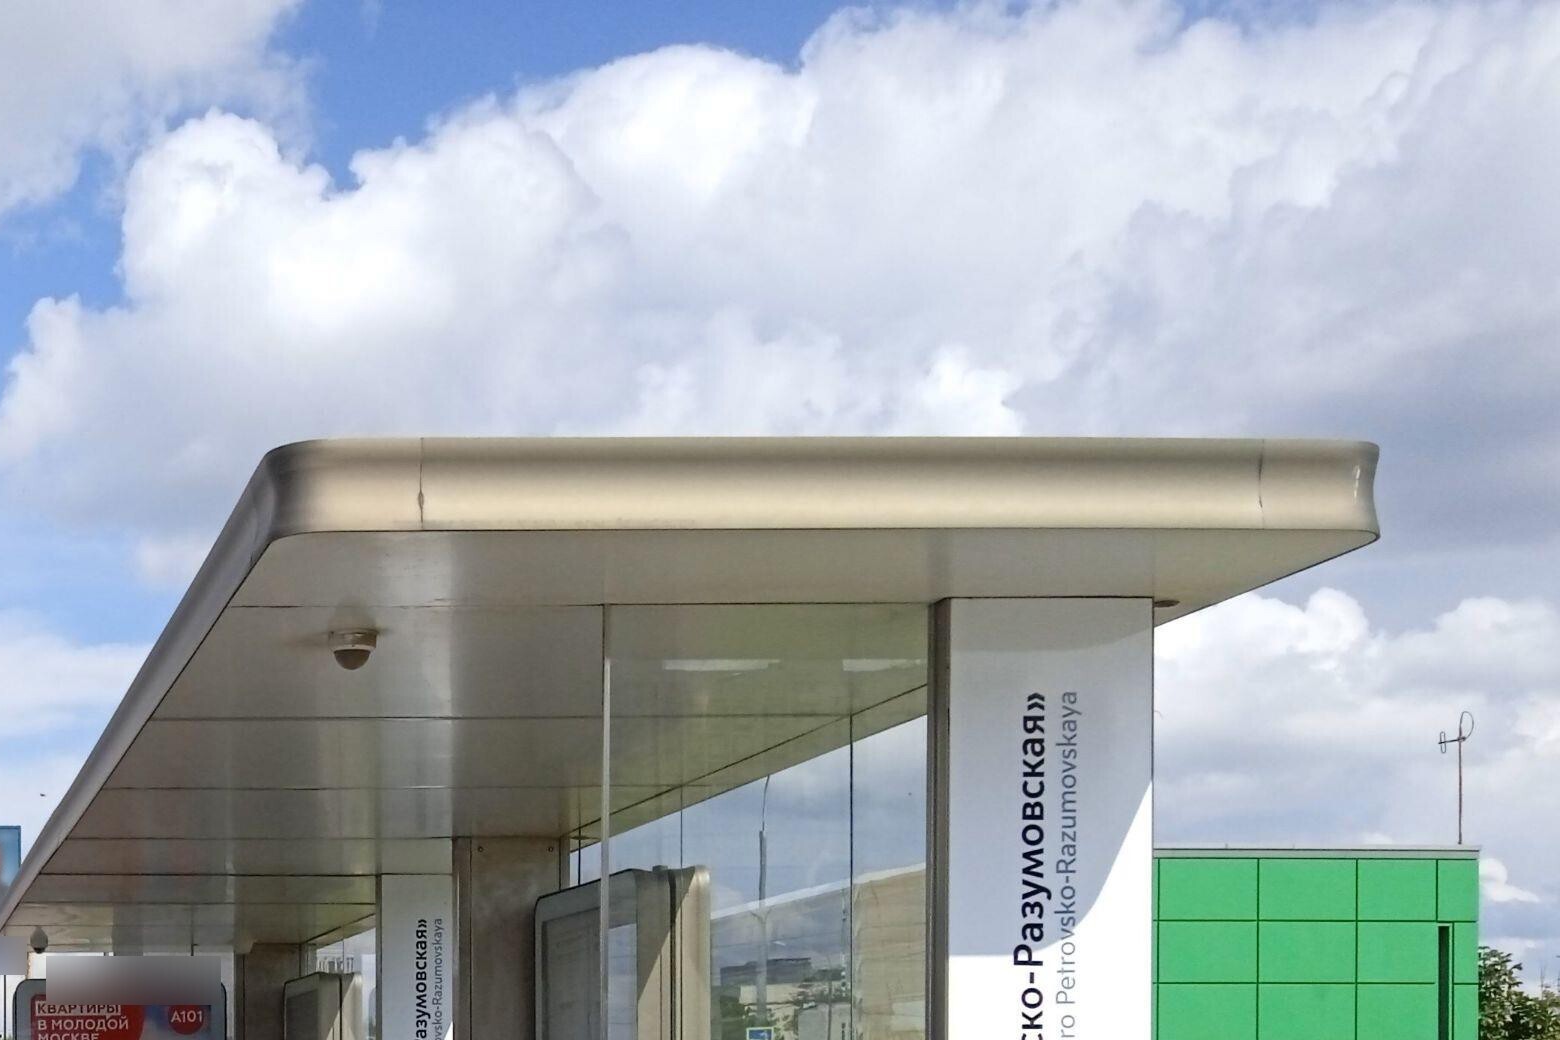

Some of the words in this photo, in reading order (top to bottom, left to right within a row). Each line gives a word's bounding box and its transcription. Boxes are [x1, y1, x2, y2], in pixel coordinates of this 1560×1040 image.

[1055, 690, 1082, 1006] Petrovsko-Razumovskaya
[38, 1019, 48, 1030] В
[51, 1015, 129, 1031] МОЛОДОЙ
